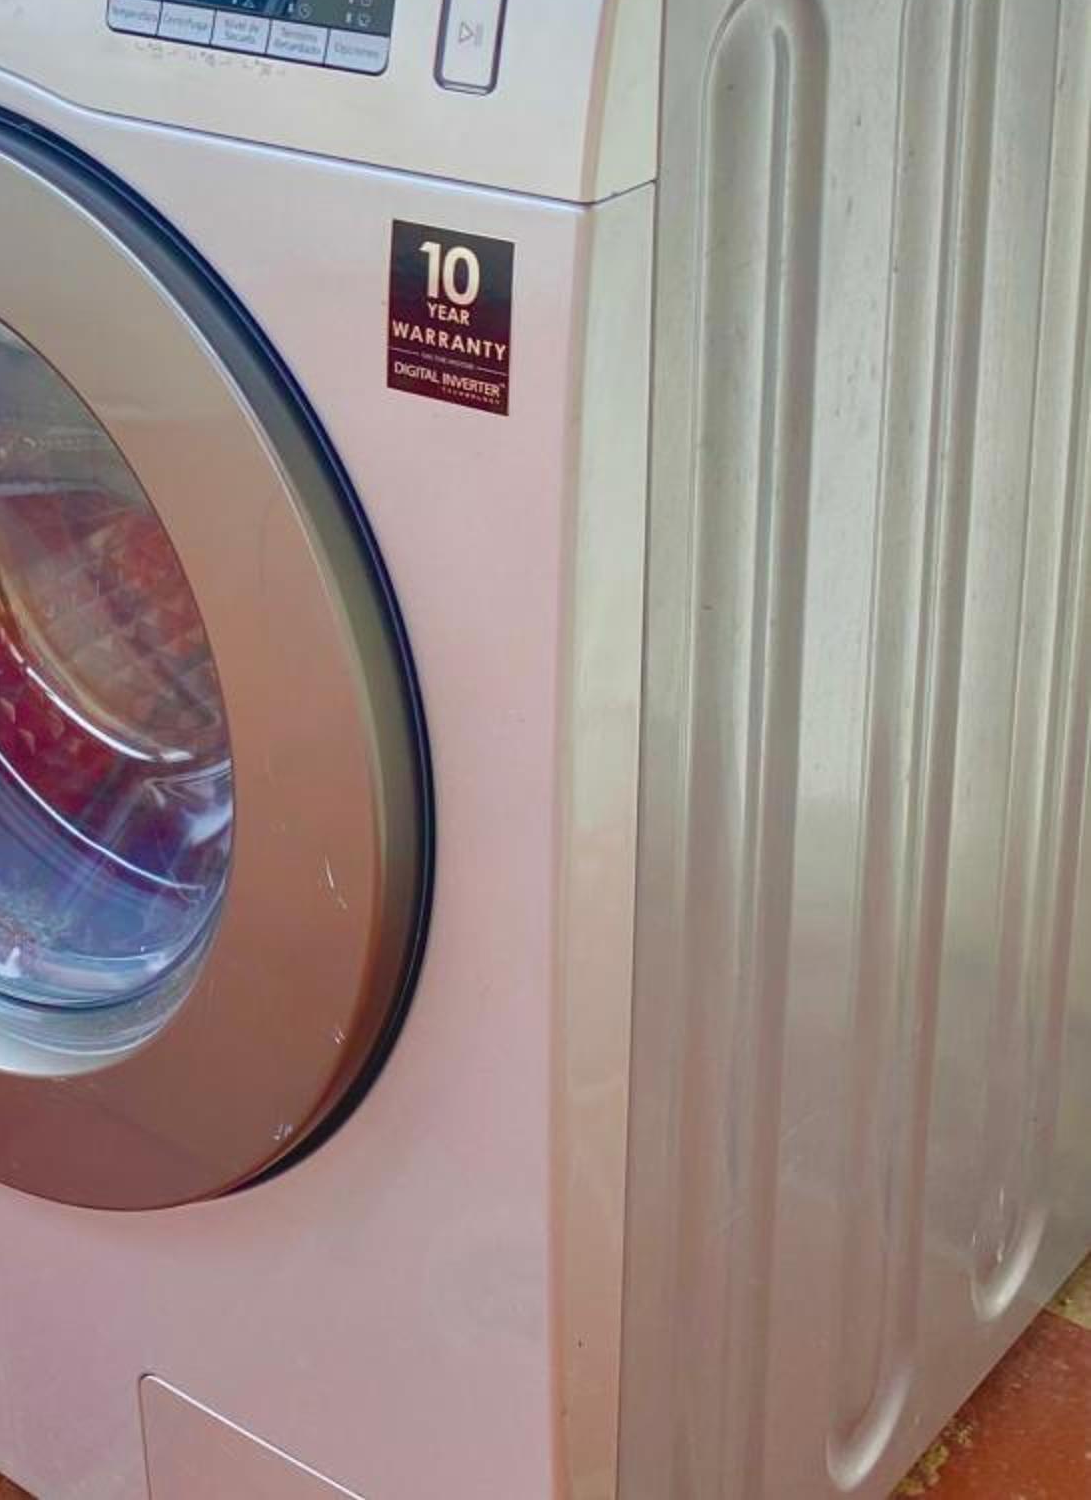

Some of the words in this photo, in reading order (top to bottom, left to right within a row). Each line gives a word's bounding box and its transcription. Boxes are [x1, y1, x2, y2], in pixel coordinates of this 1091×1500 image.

[419, 241, 479, 305] 10
[427, 302, 470, 326] YEAR
[392, 320, 507, 361] WARRANTY
[394, 361, 440, 383] DIGITAL
